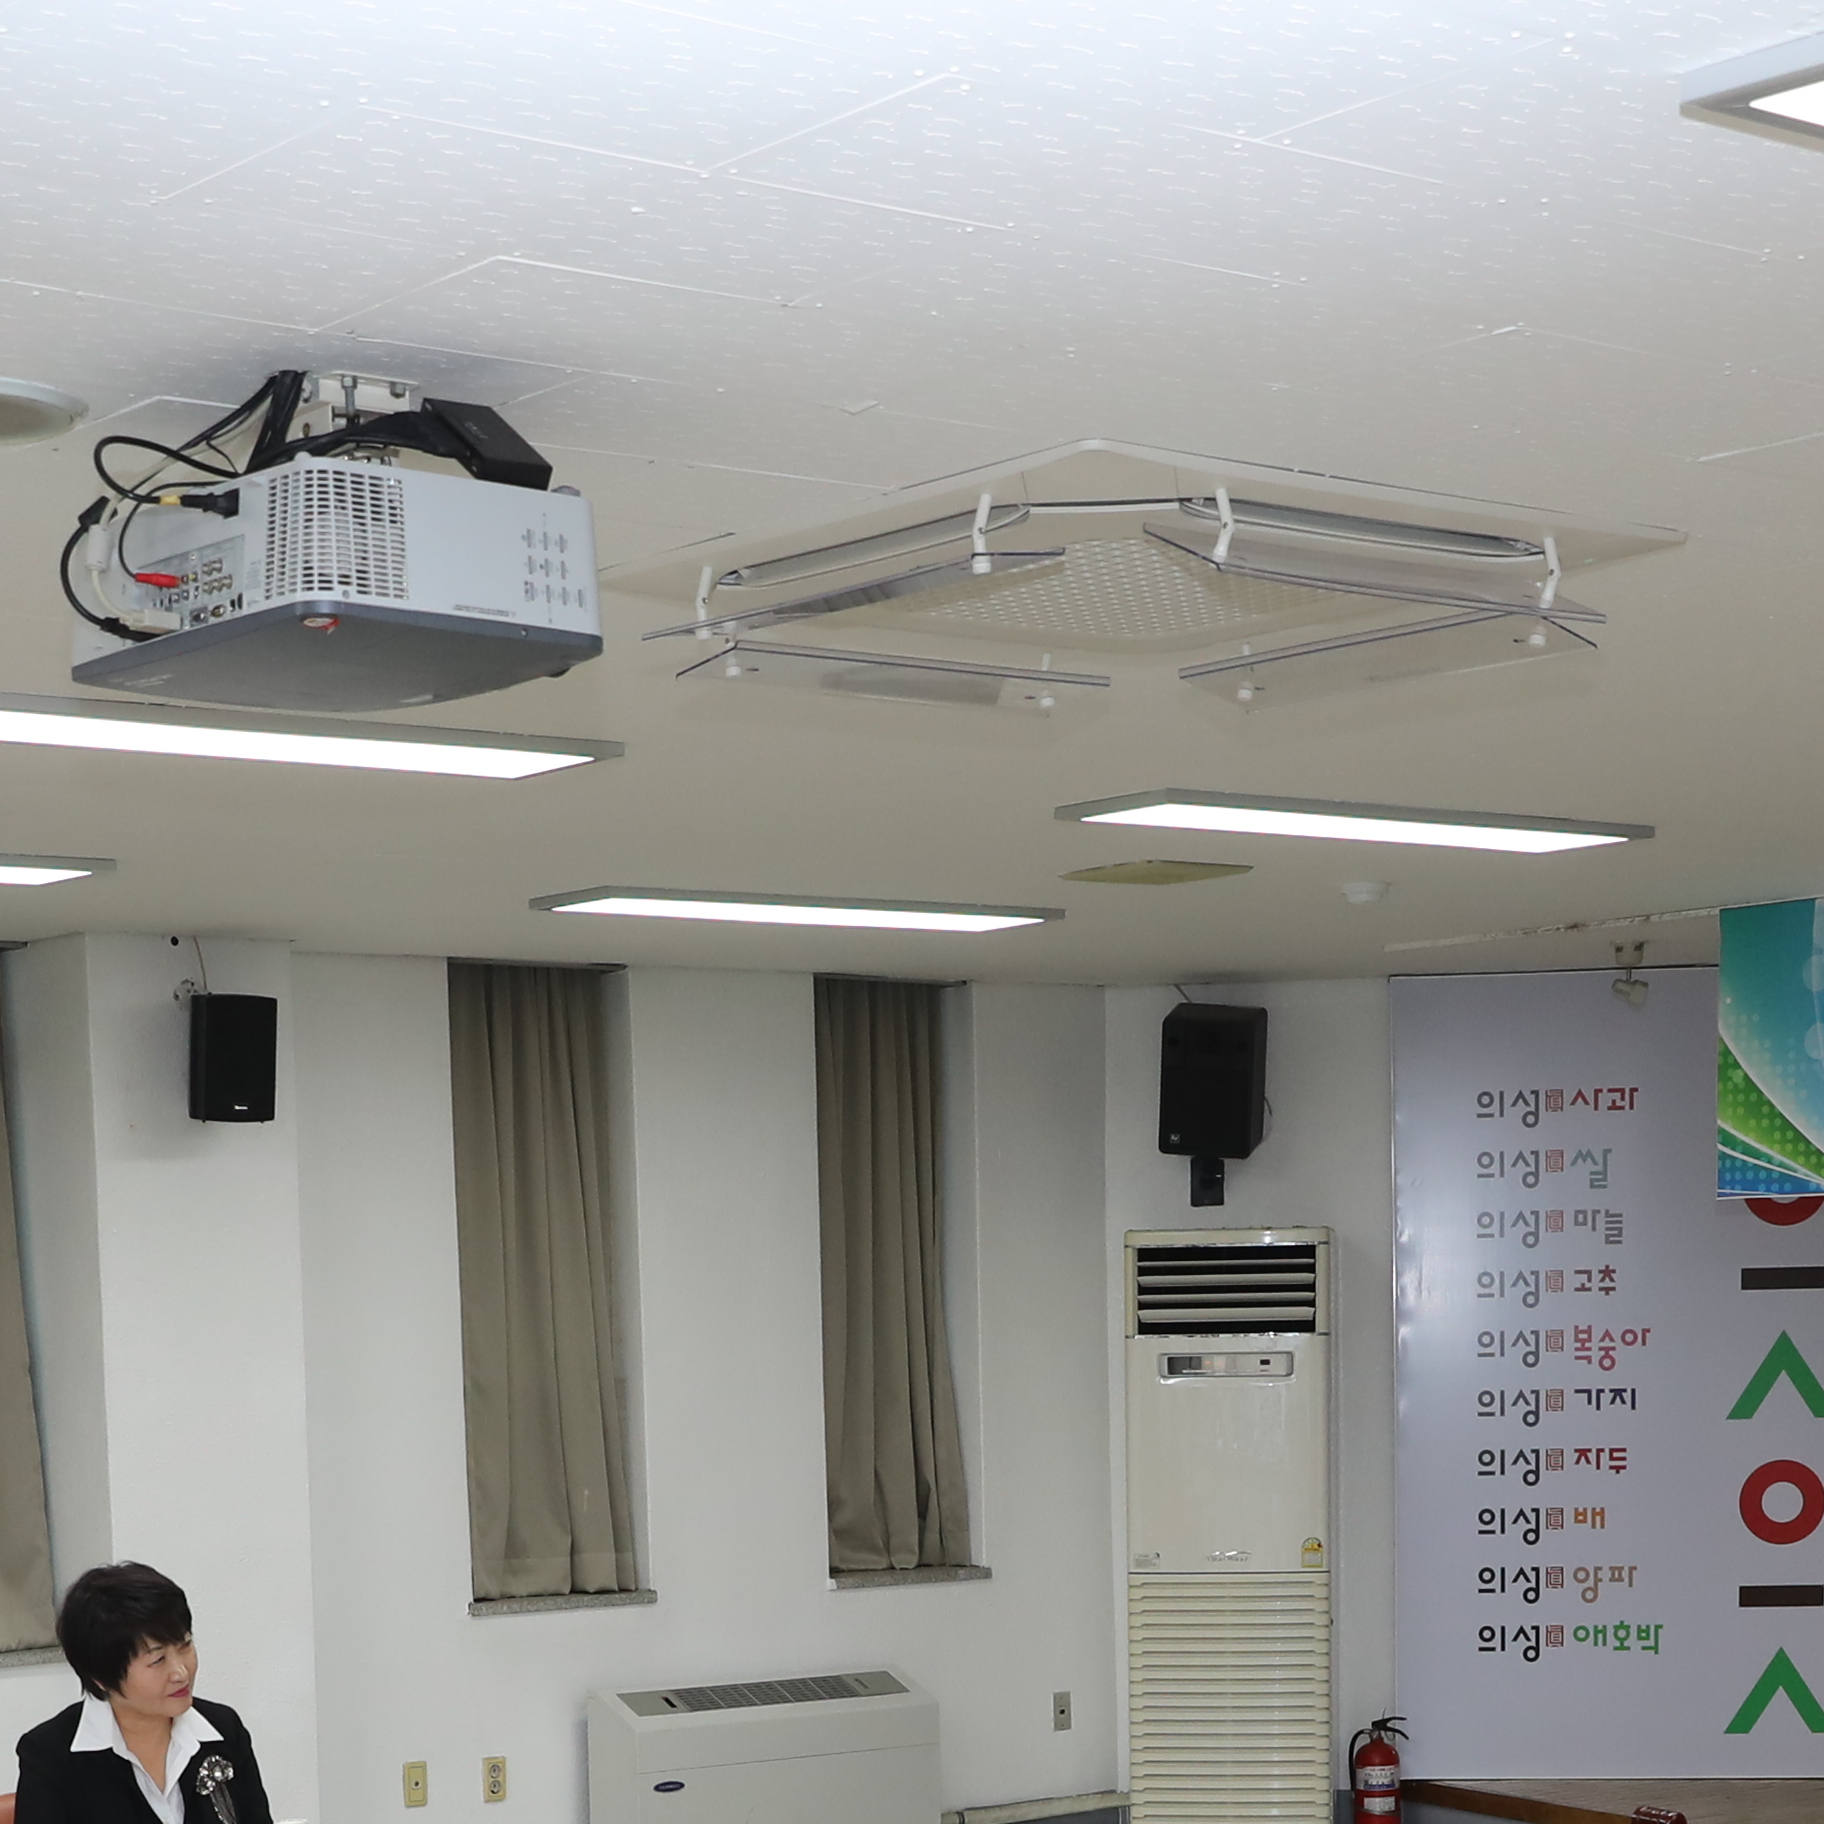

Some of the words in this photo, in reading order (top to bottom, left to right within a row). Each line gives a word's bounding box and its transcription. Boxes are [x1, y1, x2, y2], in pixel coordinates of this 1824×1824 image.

[1569, 1087, 1639, 1111] 사과
[1570, 1148, 1612, 1189] 쌀
[1574, 1209, 1623, 1245] 마늘
[1573, 1264, 1617, 1296] 고추
[1573, 1324, 1651, 1371] 복숭아
[1573, 1387, 1636, 1411] 가지
[1573, 1447, 1627, 1474] 자두
[1573, 1507, 1606, 1529] 배
[1572, 1565, 1638, 1604] 양파
[1572, 1620, 1664, 1655] 애호박
